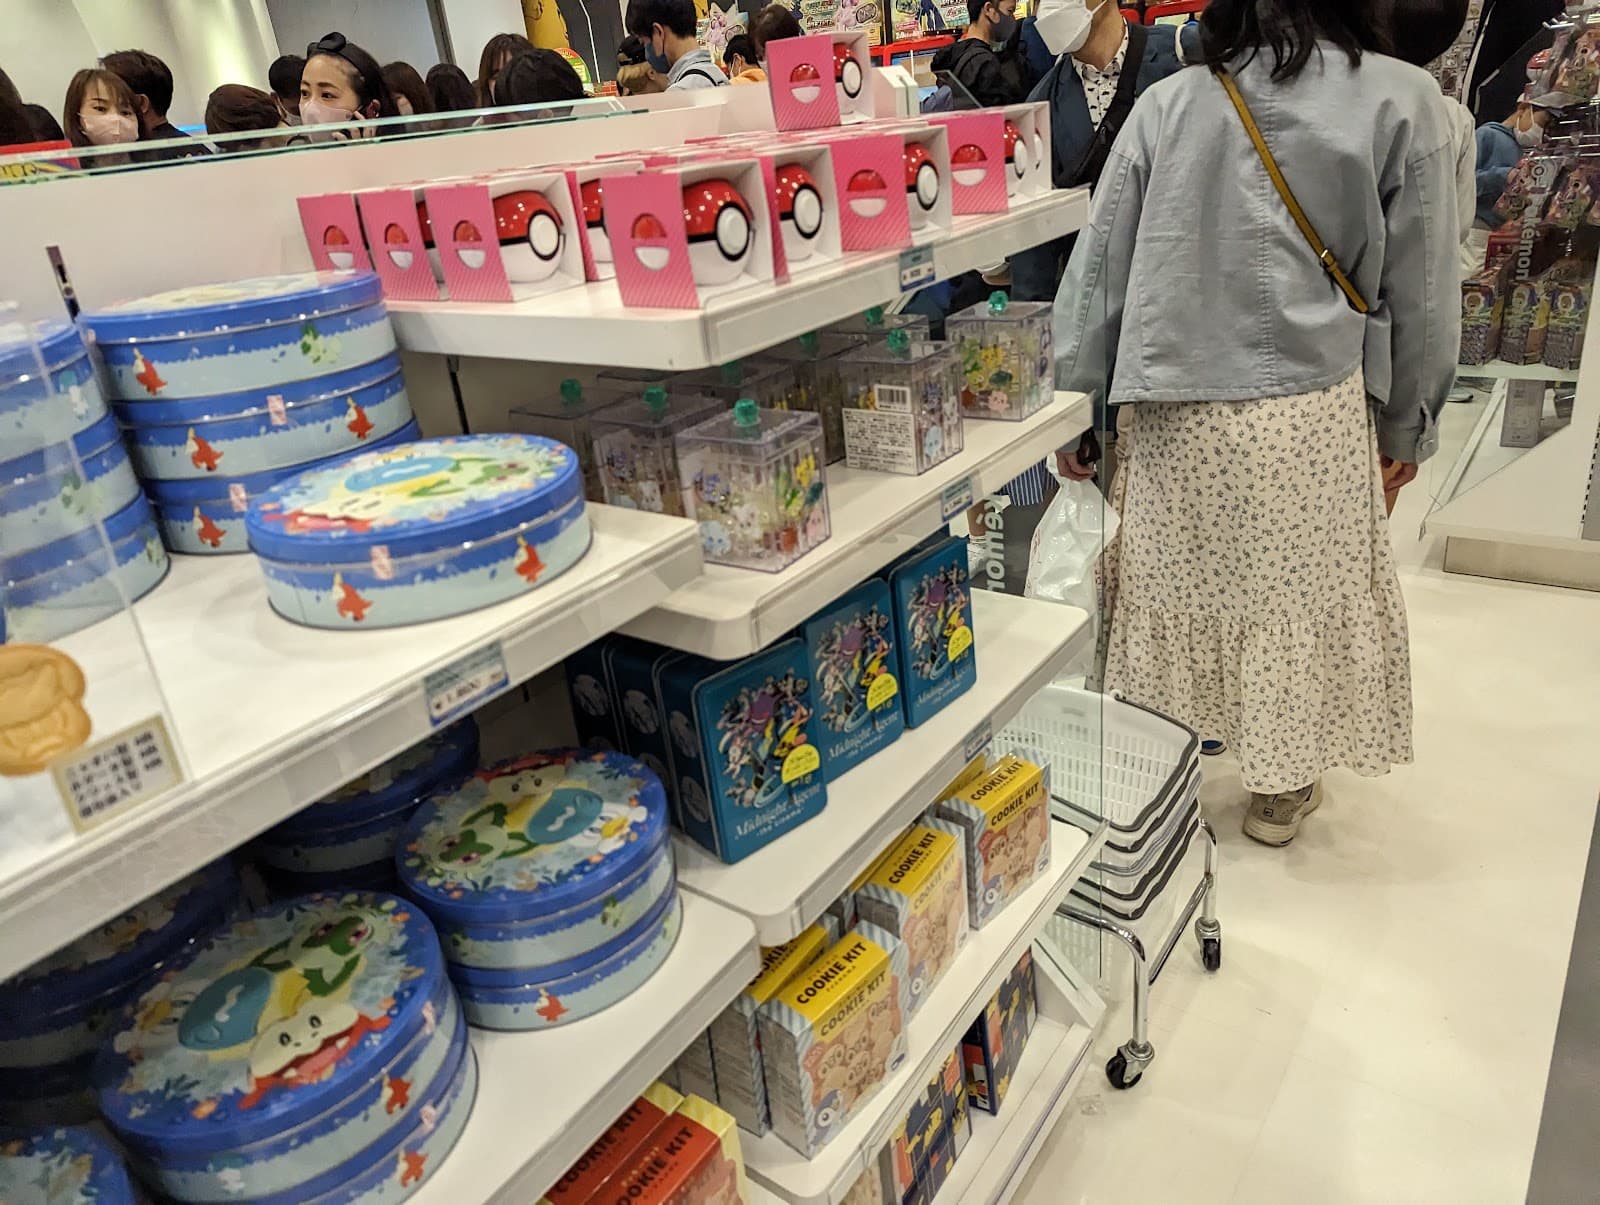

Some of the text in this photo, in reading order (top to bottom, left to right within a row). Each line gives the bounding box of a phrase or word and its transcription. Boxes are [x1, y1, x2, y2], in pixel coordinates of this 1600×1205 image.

[970, 773, 1008, 801] COOKIE
[1005, 760, 1024, 775] KIT
[991, 794, 1024, 827] COOKIE
[1025, 781, 1040, 800] KIT
[888, 848, 923, 885] COOKIE
[918, 832, 937, 849] KIT
[796, 961, 847, 1005] COOKIE
[842, 941, 867, 963] KIT
[820, 990, 866, 1037] COOKIE
[867, 970, 887, 995] KIT
[614, 1105, 643, 1132] KIT
[615, 1156, 668, 1205] OOKIE
[665, 1126, 694, 1156] KIT
